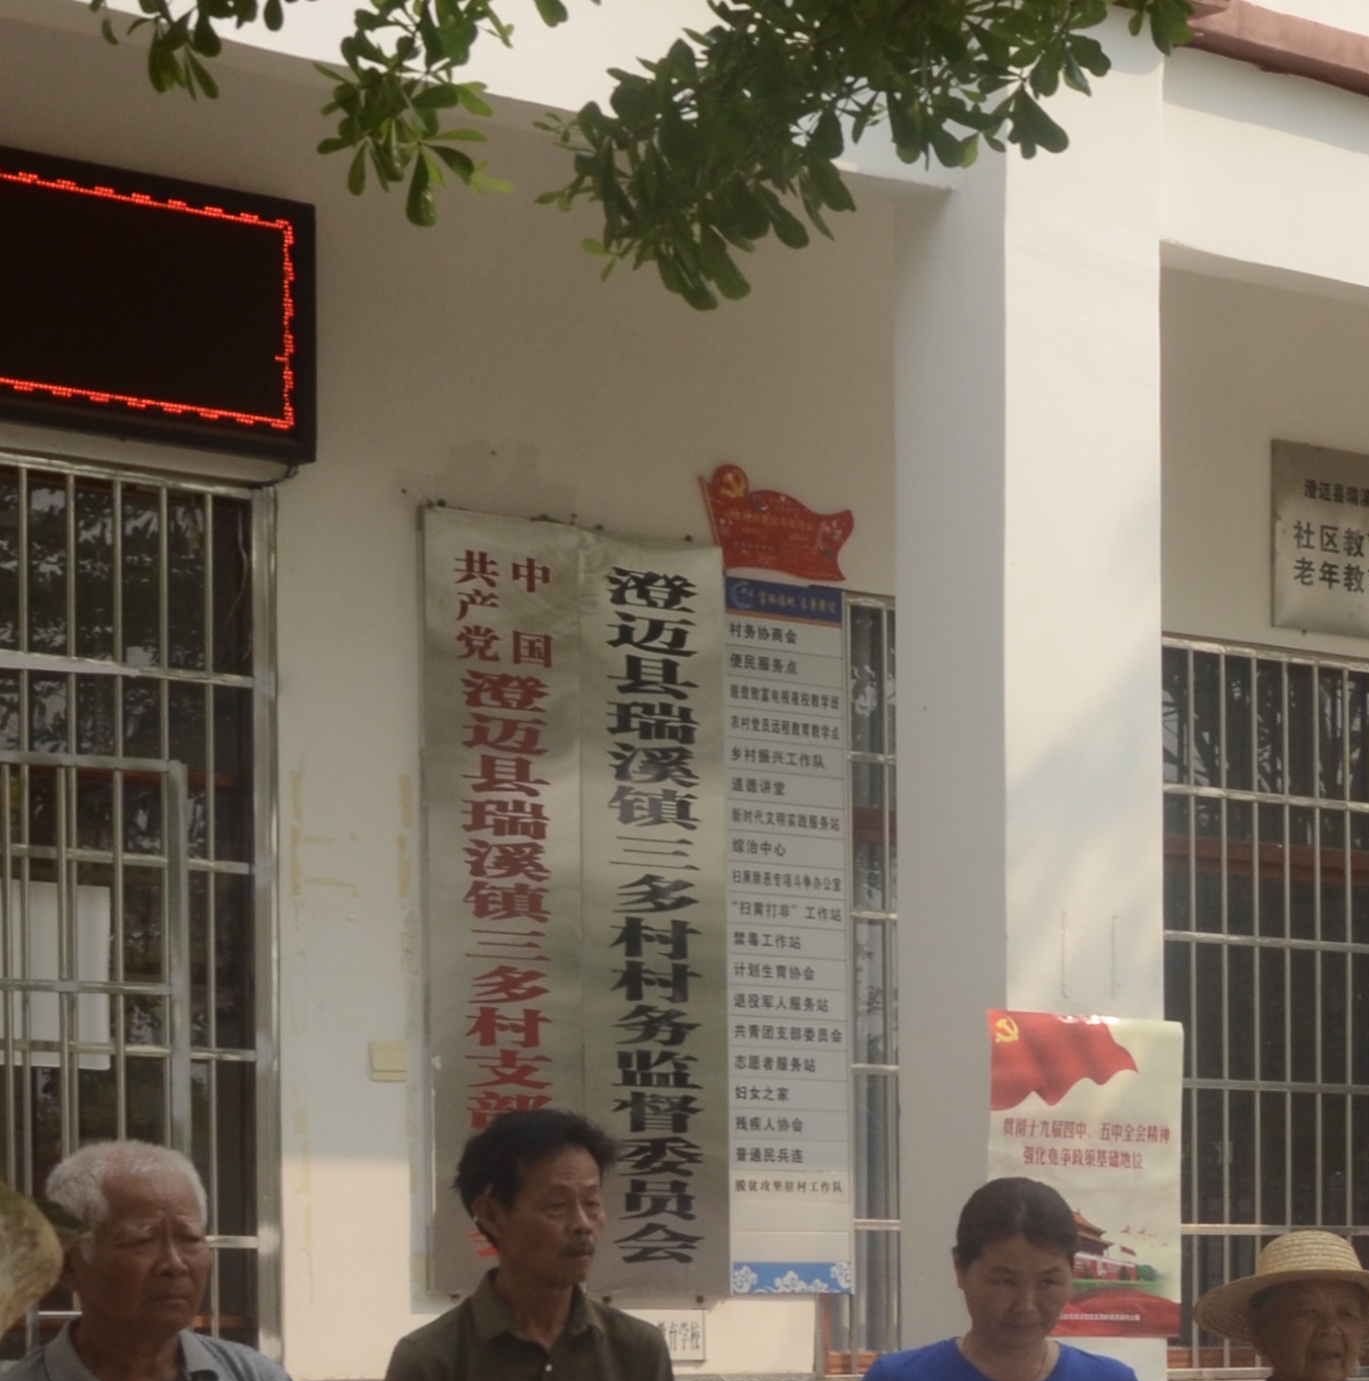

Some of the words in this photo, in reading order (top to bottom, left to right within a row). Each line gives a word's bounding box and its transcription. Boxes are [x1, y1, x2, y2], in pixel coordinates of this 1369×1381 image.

[730, 621, 797, 644] 村务协商会
[730, 652, 798, 675] 便民服务点
[731, 745, 826, 769] 乡村振兴工作队
[731, 776, 786, 796] 道德讲堂
[732, 807, 840, 832] 新时代文明实践服务站
[732, 837, 787, 857] 综治中心
[606, 566, 703, 1264] 澄迈县瑞溪镇三多村村务监督委员会
[734, 930, 801, 950] 禁毒工作站
[734, 961, 815, 981] 计划生育协会
[734, 992, 829, 1013] 退役军人服务站
[734, 1023, 843, 1044] 共青团支部委员会
[734, 1054, 816, 1073] 志愿者服务站
[735, 1084, 790, 1102] 妇女之家
[735, 1115, 803, 1133] 残疾人协会
[736, 1146, 804, 1164] 普通民兵连
[735, 1178, 844, 1194] 脱贫攻坚驻村工作队
